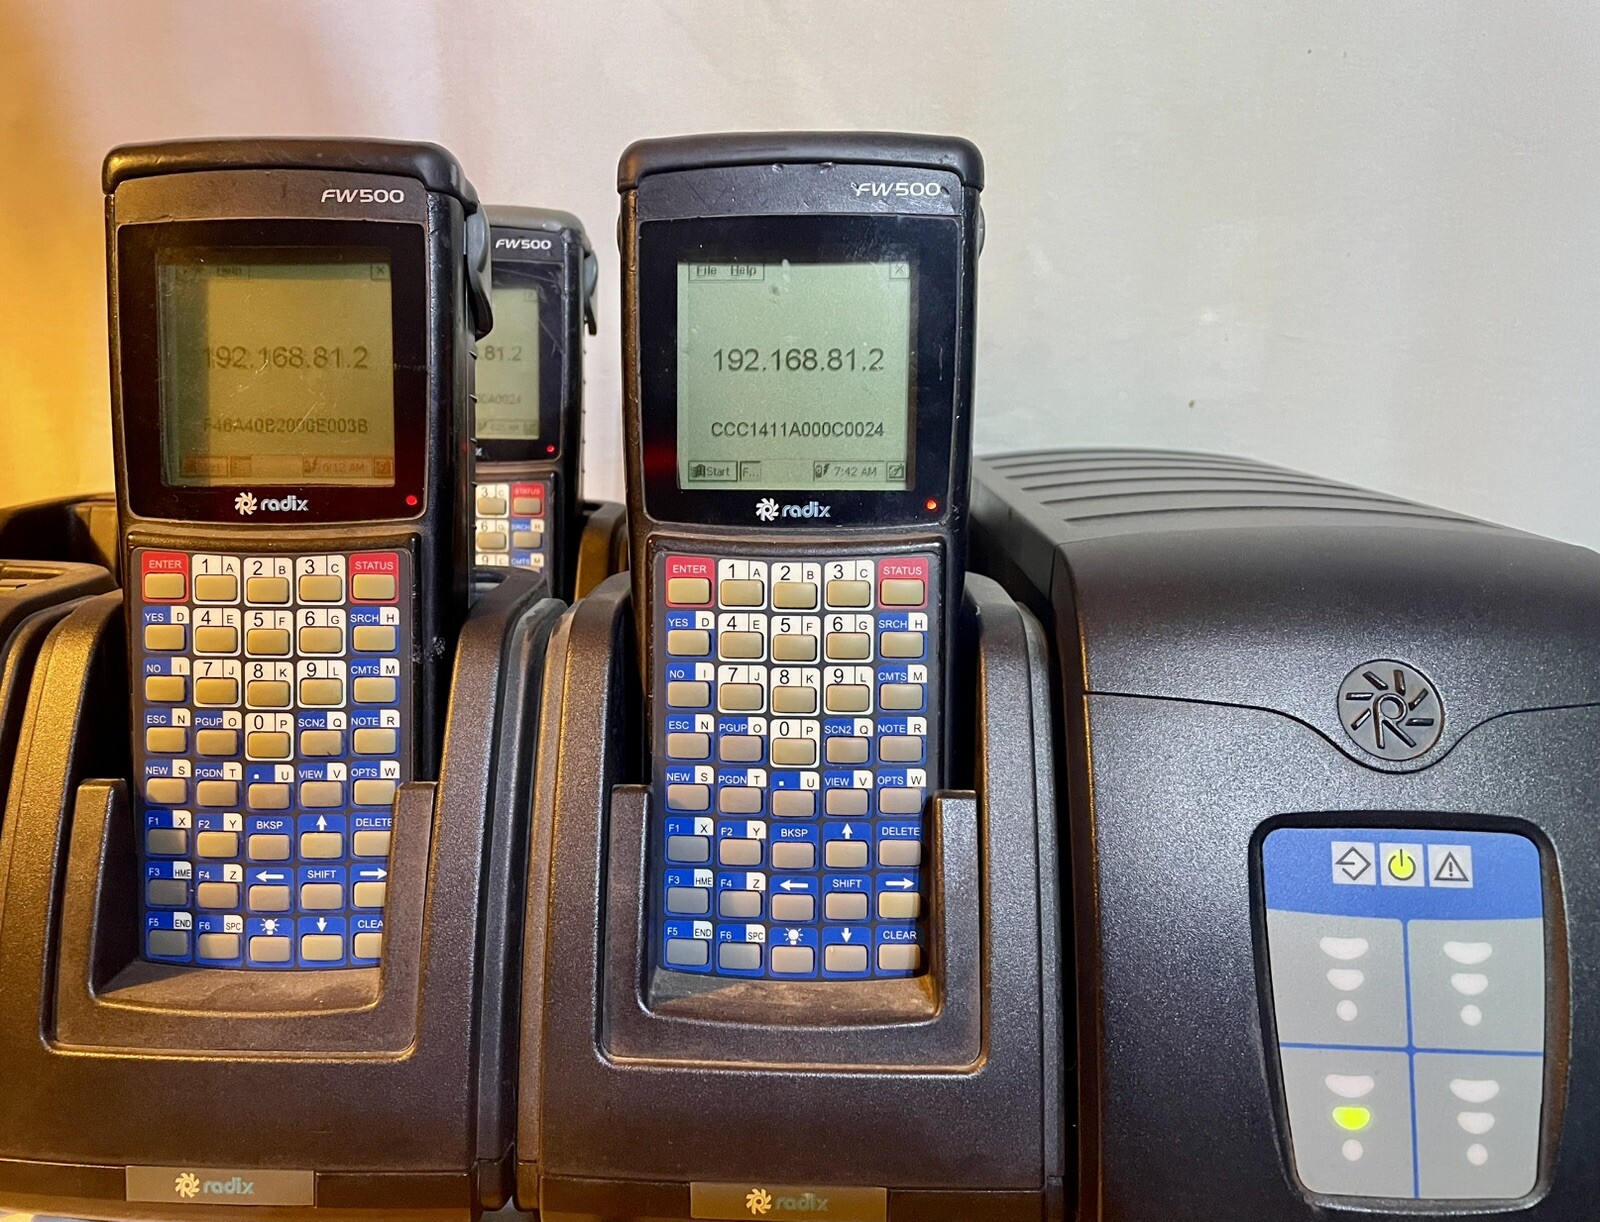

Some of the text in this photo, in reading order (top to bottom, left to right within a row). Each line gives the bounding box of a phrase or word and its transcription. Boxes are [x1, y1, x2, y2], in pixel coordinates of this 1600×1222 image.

[856, 182, 941, 197] FW500
[321, 189, 404, 203] FW500
[495, 238, 552, 250] FW500
[696, 264, 757, 276] File Help
[204, 346, 368, 369] 192.168.81.2
[713, 348, 884, 372] 192.168.81.2
[711, 422, 884, 437] CCC1411A000C0024
[706, 467, 729, 476] Start
[861, 467, 877, 476] AM
[261, 495, 308, 511] radix
[782, 501, 831, 518] radix
[148, 560, 182, 570] ENTER
[202, 558, 234, 574] 1 A
[252, 560, 286, 576] 2 B
[305, 559, 339, 574] 3 C
[354, 560, 394, 570] STATUS
[672, 564, 707, 574] ENTER
[729, 564, 761, 578] 1 A
[780, 565, 814, 581] 2 B
[833, 564, 868, 579] 3 C
[883, 566, 922, 575] STATUS
[144, 612, 185, 622] YES D
[201, 611, 234, 625] 4 E
[253, 612, 286, 628] 5 F
[305, 610, 340, 626] 6 G
[350, 614, 395, 623] SRCH H
[668, 618, 710, 627] YES D
[726, 615, 760, 630] 4 E
[780, 617, 813, 633] 5 F
[832, 616, 868, 631] 6 G
[878, 619, 923, 629] SRCH H
[146, 664, 161, 673] NO
[203, 662, 235, 677] 7 J
[253, 663, 288, 678] 8 K
[306, 662, 339, 677] 9 L
[350, 665, 395, 675] CMTS M
[669, 669, 684, 678] NO
[728, 667, 760, 682] 7 J
[779, 669, 814, 685] 8 K
[833, 668, 866, 683] 9 L
[878, 671, 923, 682] CMTS M
[147, 714, 186, 724] ESC N
[195, 717, 223, 727] PGUP
[280, 719, 287, 729] P
[298, 718, 342, 728] SCN2 Q
[351, 716, 395, 726] NOTE R
[668, 720, 709, 730] ESC N
[719, 723, 748, 733] PGUP
[824, 725, 869, 735] SCN2 Q
[878, 723, 922, 734] NOTE R
[806, 726, 814, 735] P
[145, 766, 186, 775] NEW S
[195, 768, 237, 778] PGDN T
[298, 769, 341, 779] VIEW V
[351, 767, 396, 777] OPTS W
[281, 771, 290, 781] U
[666, 772, 708, 782] NEW S
[718, 775, 761, 785] PGDN T
[824, 776, 867, 786] VIEW V
[877, 775, 922, 785] OPTS W
[807, 778, 815, 788] U
[148, 816, 186, 826] F1 X
[198, 819, 237, 829] F2 Y
[256, 820, 283, 830] BKSP
[355, 817, 392, 827] DELETE
[668, 824, 708, 833] F1 X
[721, 827, 760, 836] F2 Y
[780, 828, 808, 838] BKSP
[881, 826, 920, 836] DELETE
[148, 867, 191, 878] F3 HME
[198, 870, 237, 880] F4 Z
[307, 869, 336, 879] SHIFT
[668, 874, 712, 886] F3 HME
[720, 878, 760, 888] F4 Z
[832, 878, 862, 888] SHIFT
[148, 917, 191, 928] F5 END
[199, 921, 241, 931] F6 SPC
[357, 919, 384, 929] CLEA
[667, 926, 712, 937] F5 END
[720, 930, 764, 941] F6 SPC
[882, 930, 917, 940] CLEAR
[203, 1177, 254, 1194] radix
[775, 1193, 829, 1211] radix
